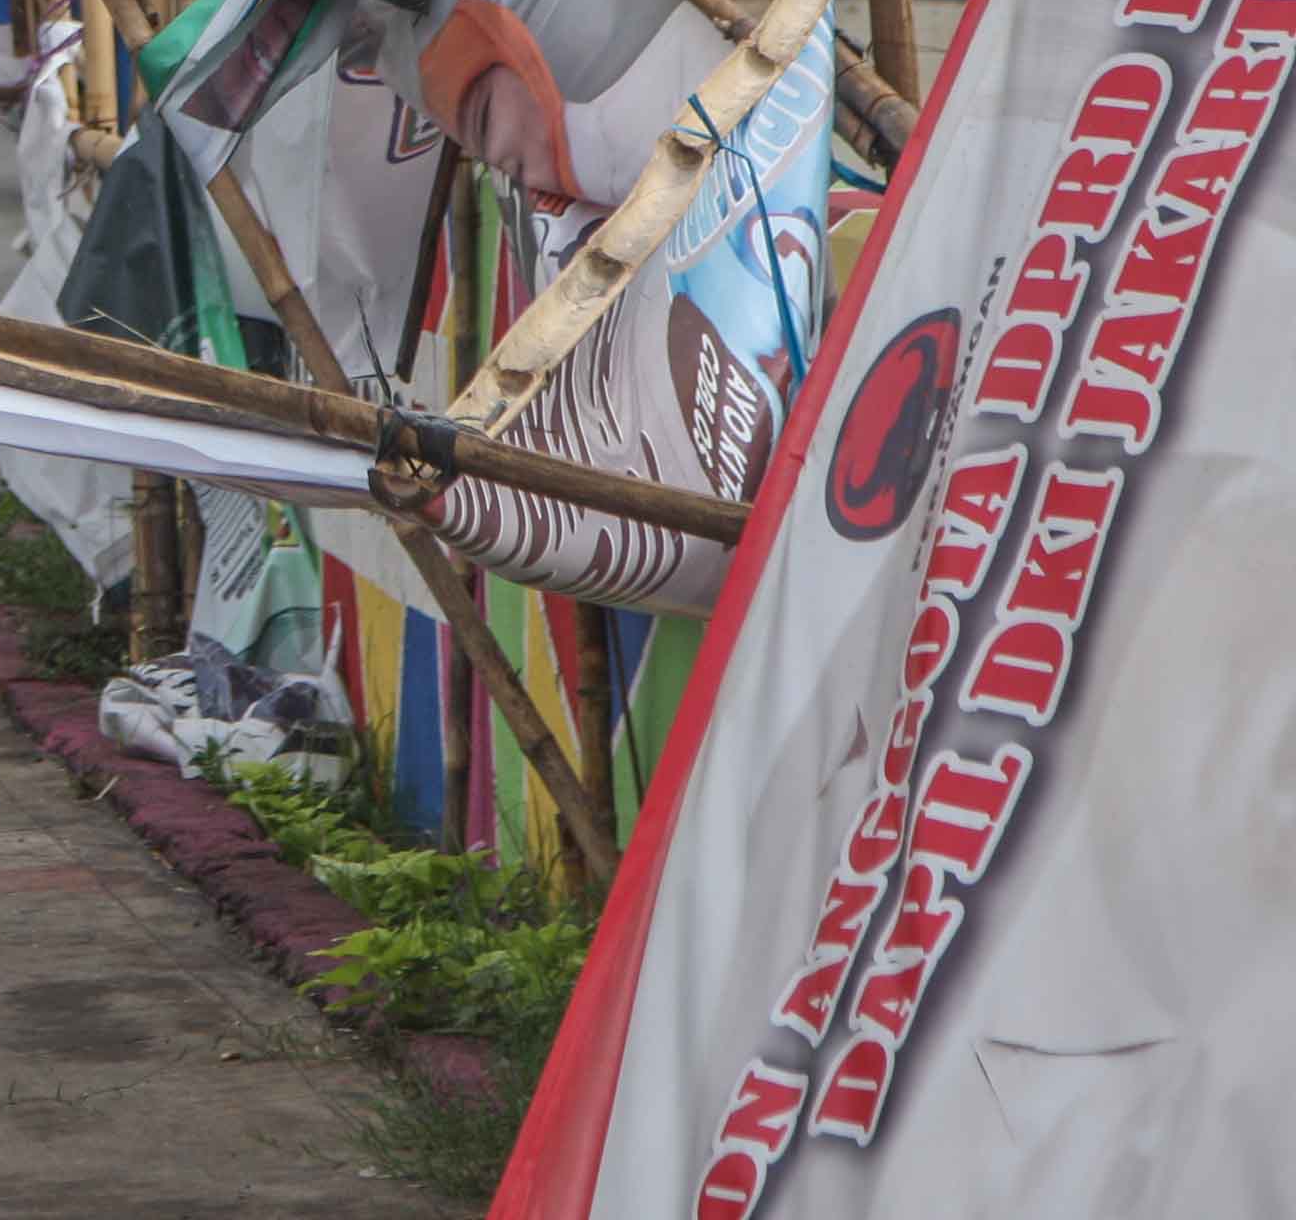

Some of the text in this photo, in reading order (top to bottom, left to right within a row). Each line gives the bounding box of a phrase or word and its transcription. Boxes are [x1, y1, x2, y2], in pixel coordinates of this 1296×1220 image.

[722, 362, 759, 445] AYO
[776, 448, 1024, 1042] ANGGOTA
[970, 58, 1168, 416] DPRD
[810, 750, 1026, 1137] DAPIL
[966, 468, 1119, 720] DKI
